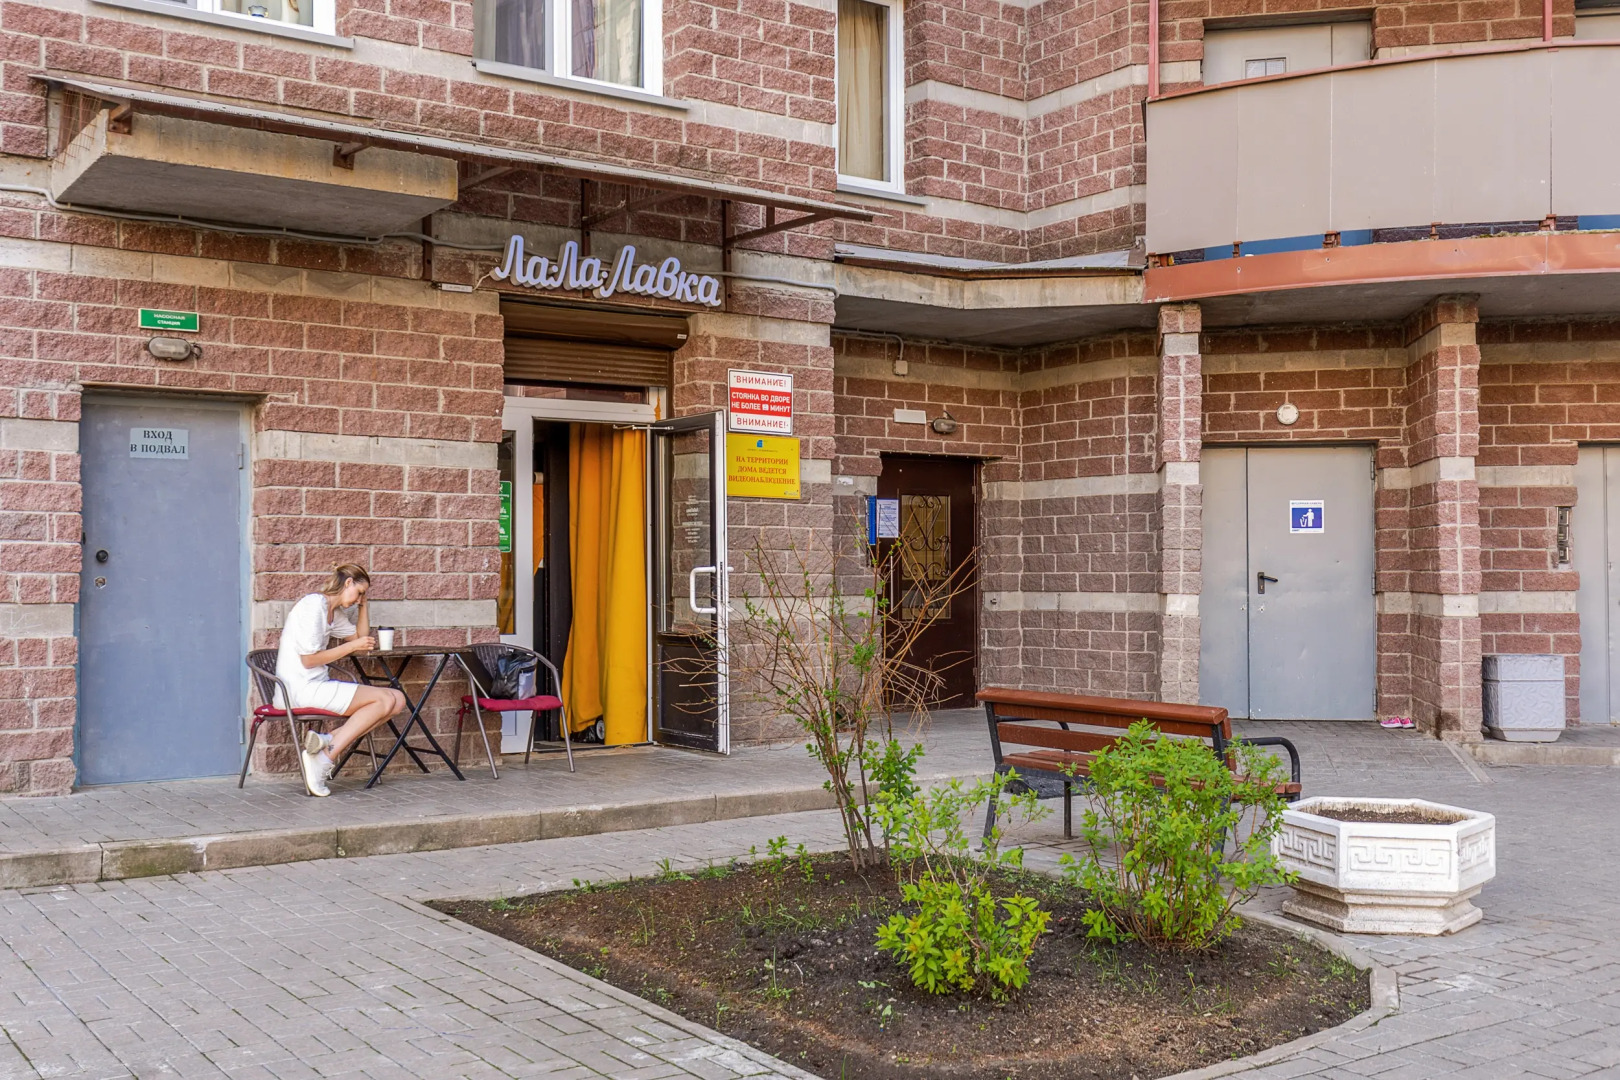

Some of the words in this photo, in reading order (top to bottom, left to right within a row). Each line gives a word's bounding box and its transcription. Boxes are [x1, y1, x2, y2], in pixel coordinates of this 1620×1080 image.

[736, 375, 787, 388] ВНИМАНИЕ!
[731, 391, 760, 401] СТОЯНКА
[760, 394, 769, 402] ВО
[770, 395, 791, 404] ДВОРЕ
[741, 402, 761, 411] БОЛЕЕ
[770, 404, 791, 413] МИНУТ
[736, 417, 786, 429] ВНИМАНИЕ!
[143, 430, 173, 443] ВХОД
[130, 443, 138, 452] В
[141, 444, 186, 455] ПОДВАЛ
[735, 455, 746, 463] НА
[746, 456, 789, 466] ТЕРРИТОРИИ
[737, 465, 758, 473] ДОМА
[758, 467, 787, 475] ВЕДЕТСЯ
[728, 475, 796, 485] ВИДЕОНАБЛЮДЕНИЕ
